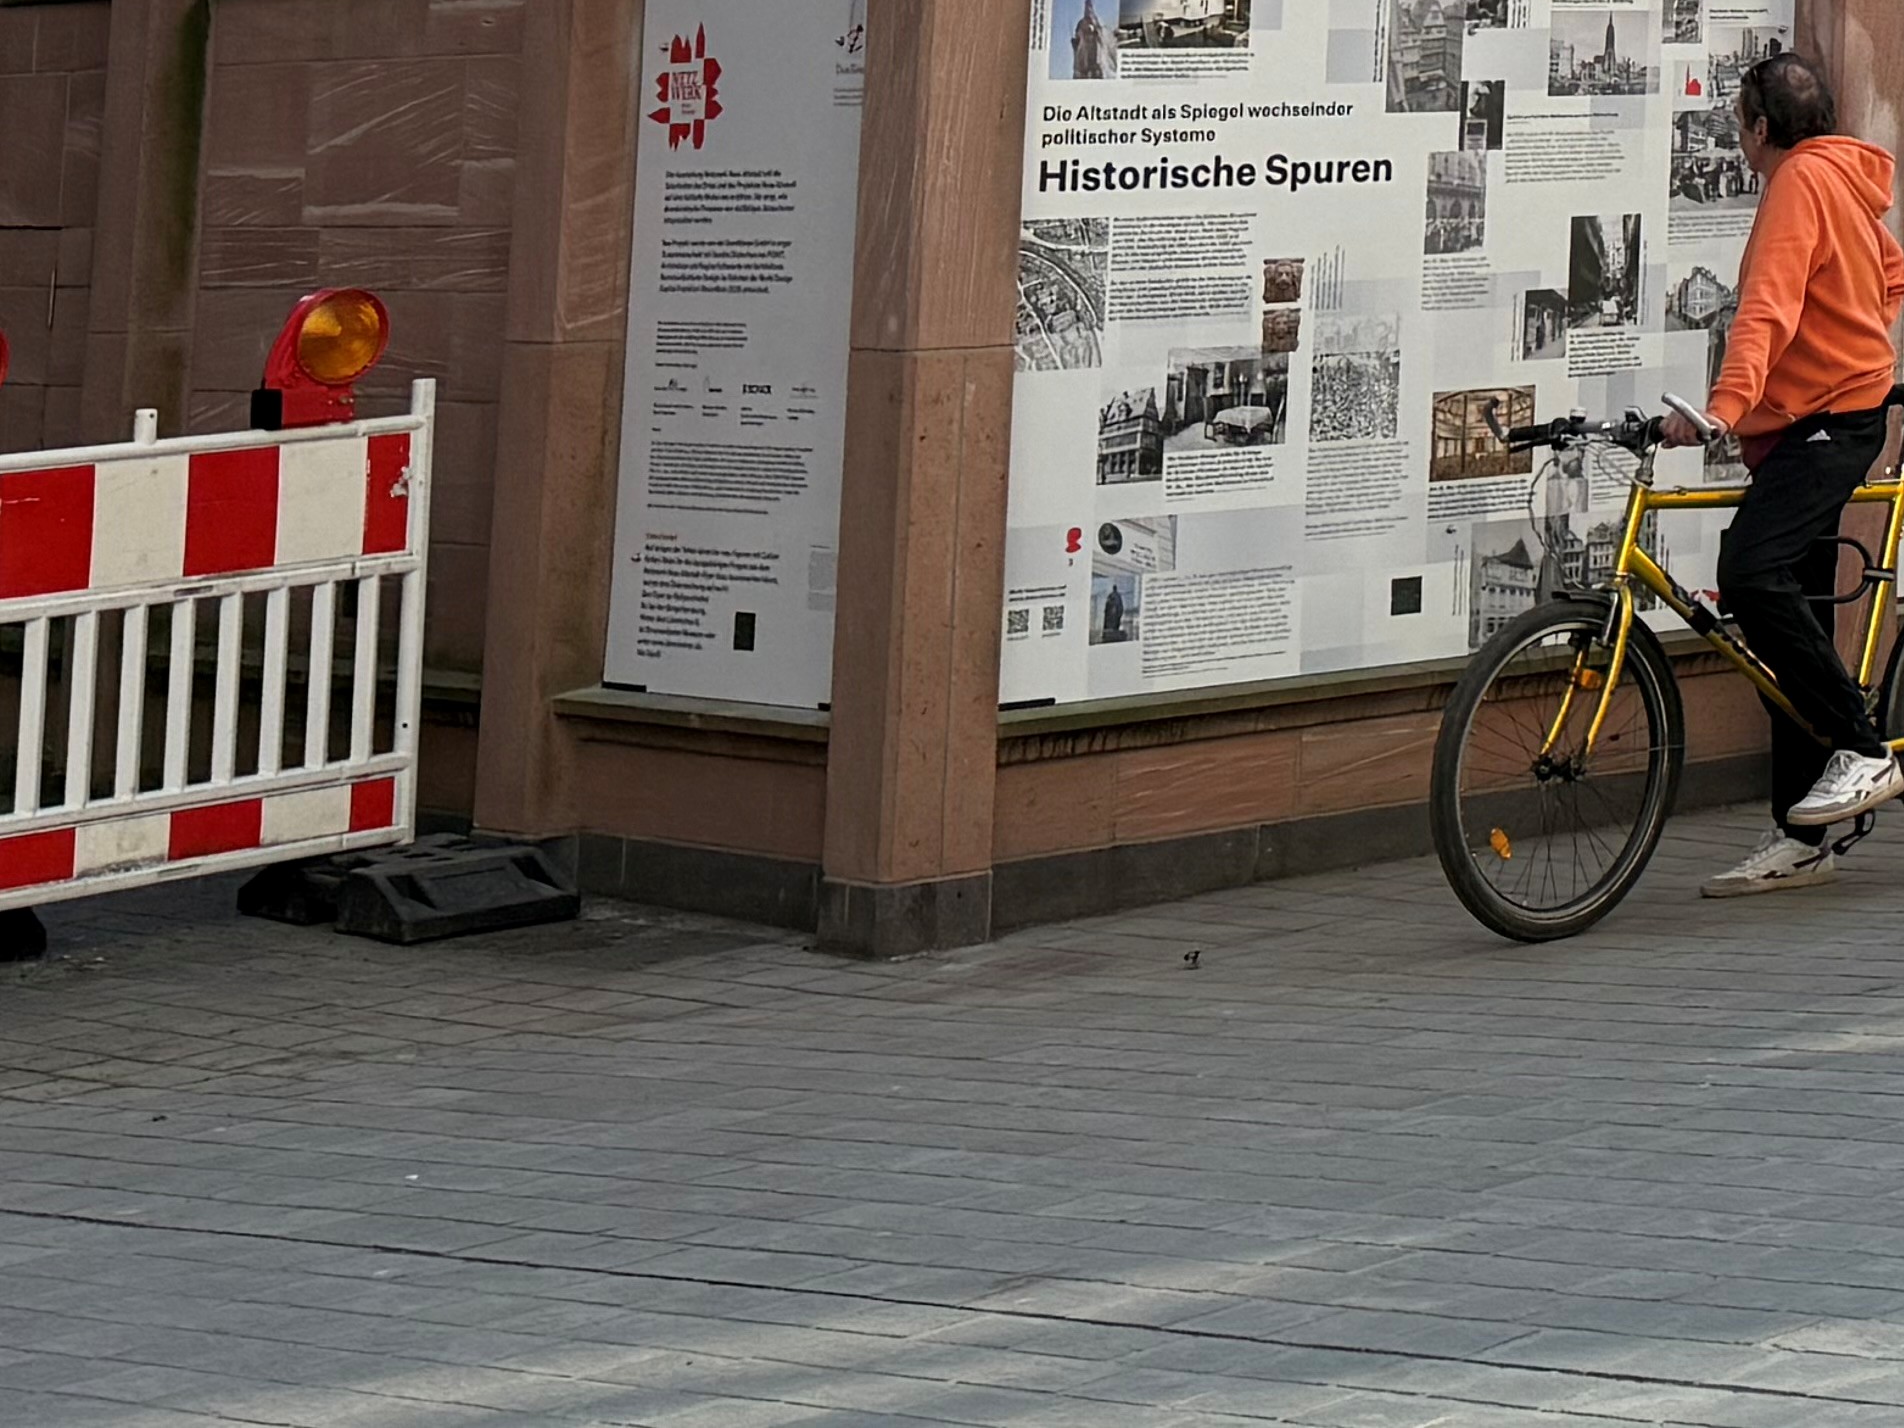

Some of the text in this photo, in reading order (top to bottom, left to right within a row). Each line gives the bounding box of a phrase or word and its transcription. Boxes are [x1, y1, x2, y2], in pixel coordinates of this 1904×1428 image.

[1043, 101, 1353, 123] Die Altstadt als Spiegel wechselnder
[1042, 128, 1216, 147] politischer Systeme
[1039, 153, 1393, 192] Historische Spuren
